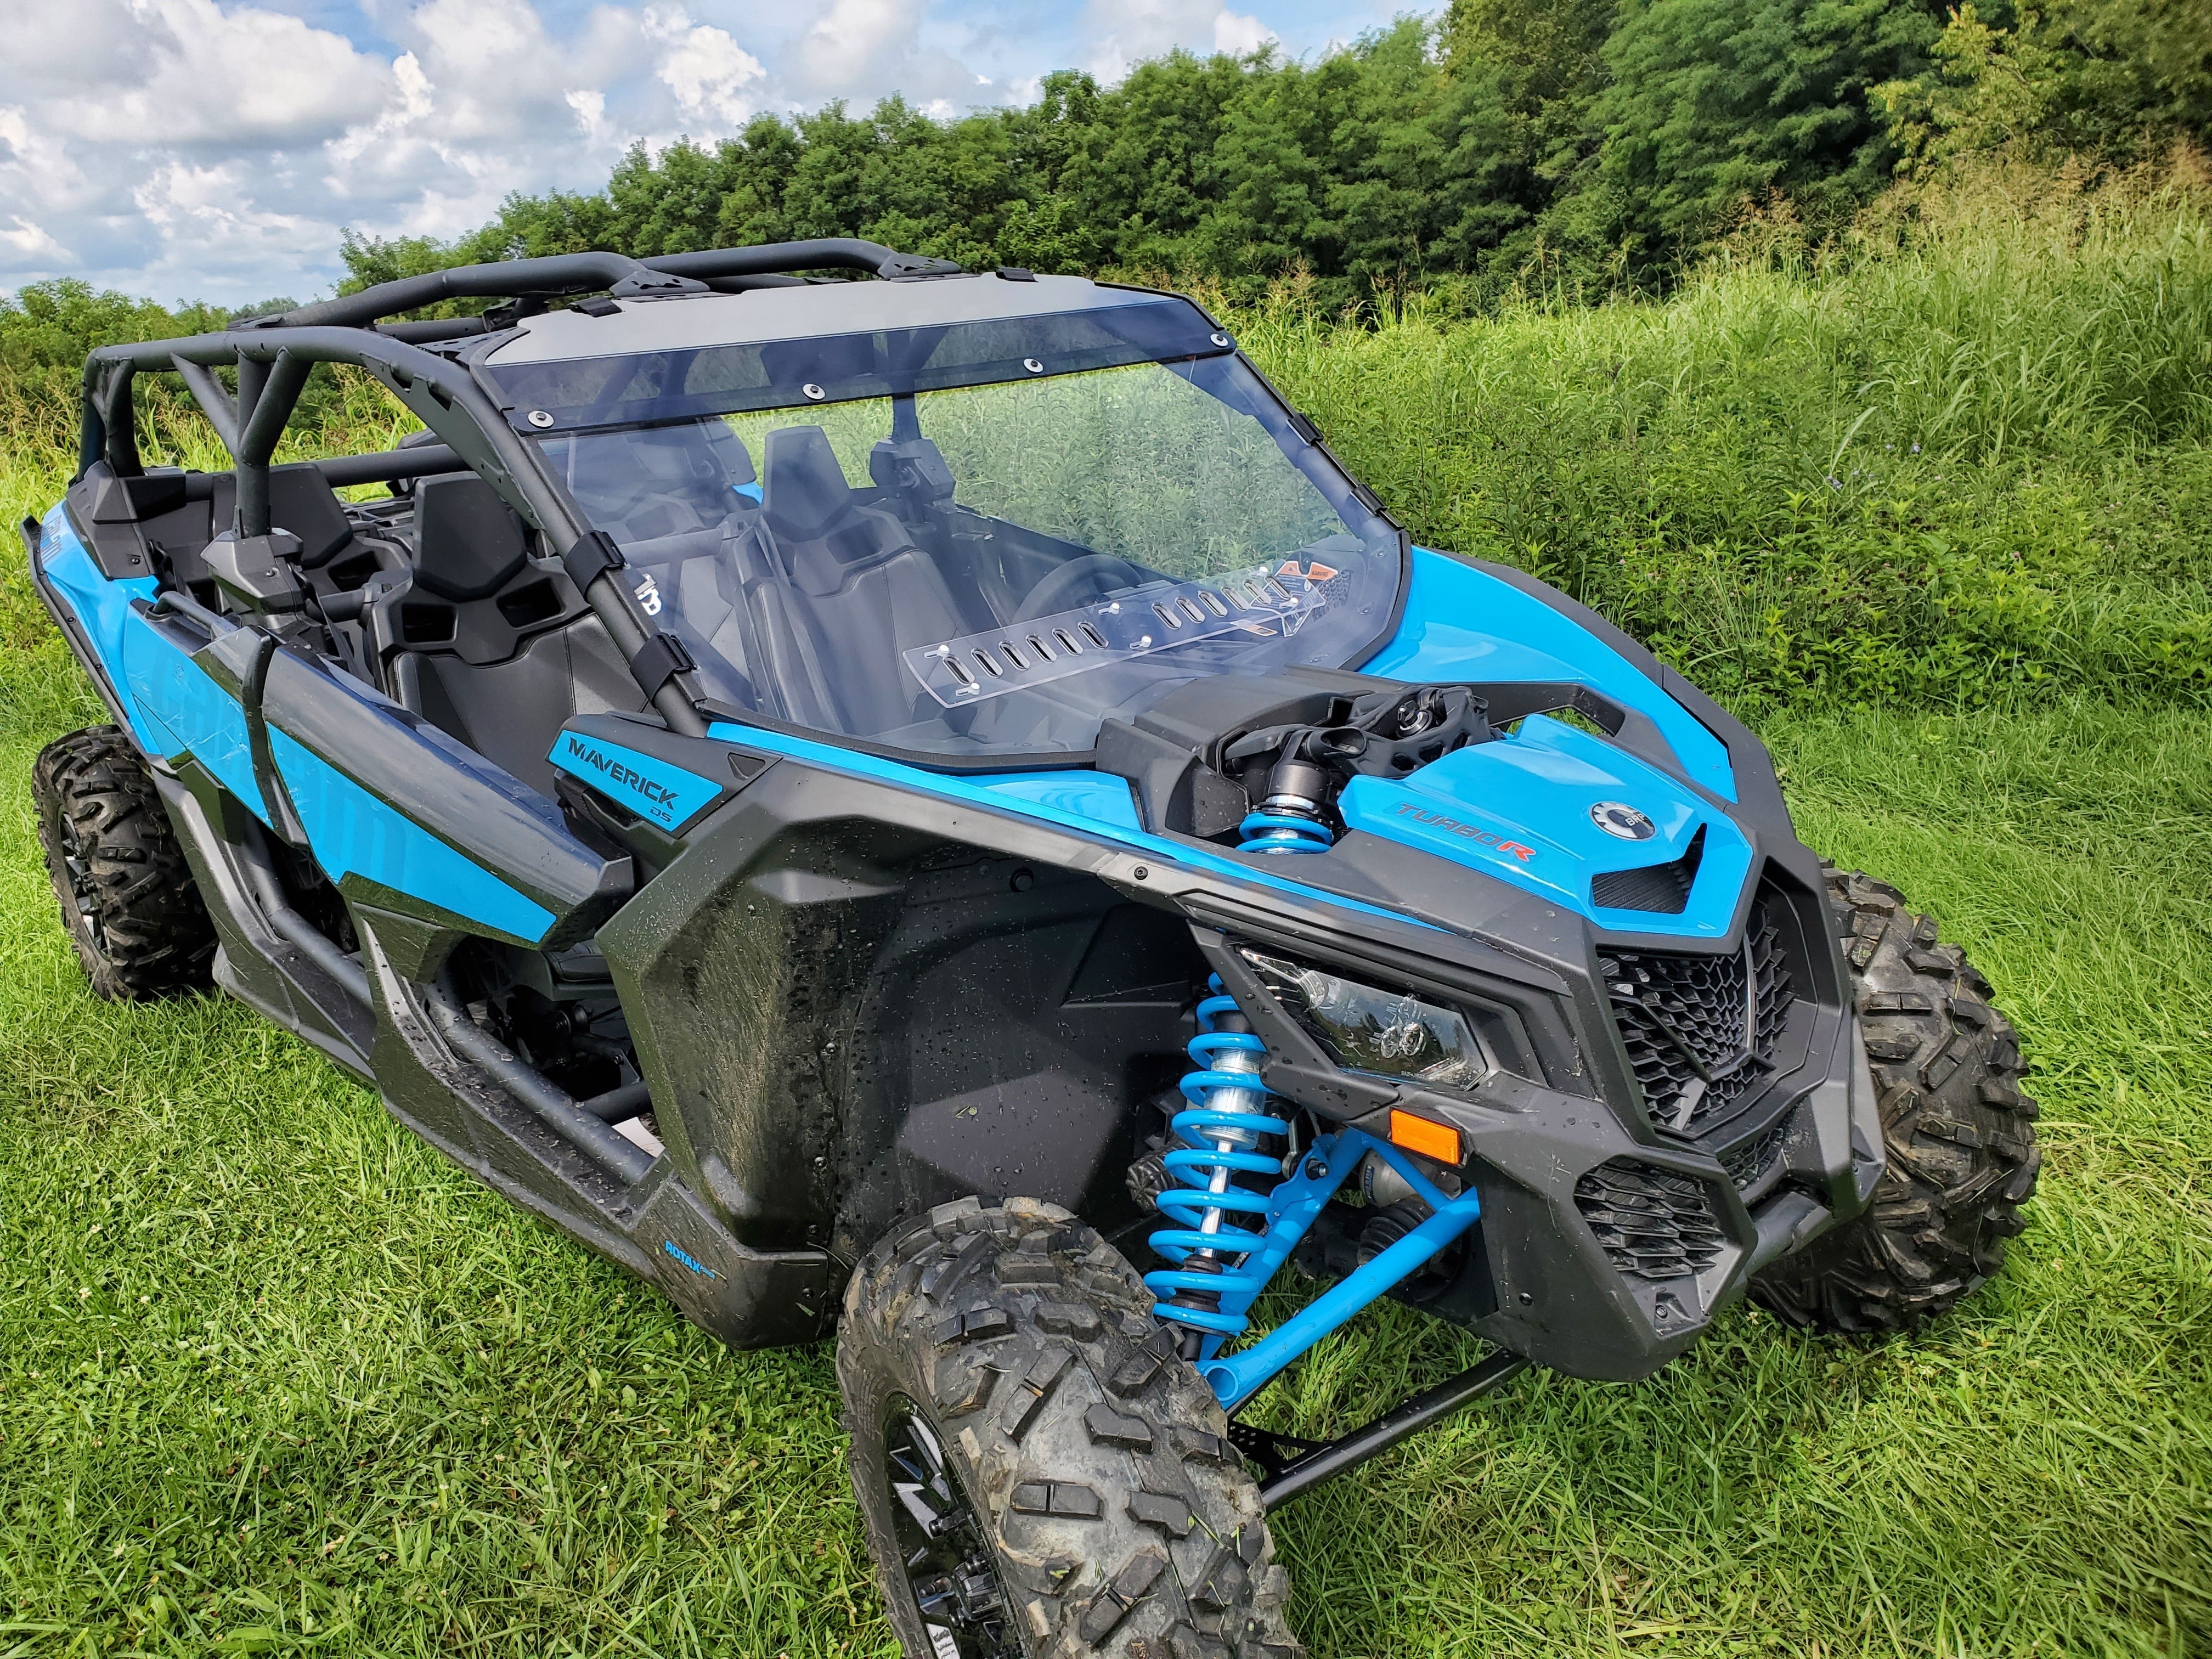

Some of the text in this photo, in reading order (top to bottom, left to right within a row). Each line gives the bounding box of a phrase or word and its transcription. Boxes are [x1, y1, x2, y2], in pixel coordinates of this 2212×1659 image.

[568, 737, 679, 810] MAVERICK
[650, 806, 673, 823] DS
[1624, 813, 1645, 826] BRP
[664, 1239, 701, 1274] ROTAX
